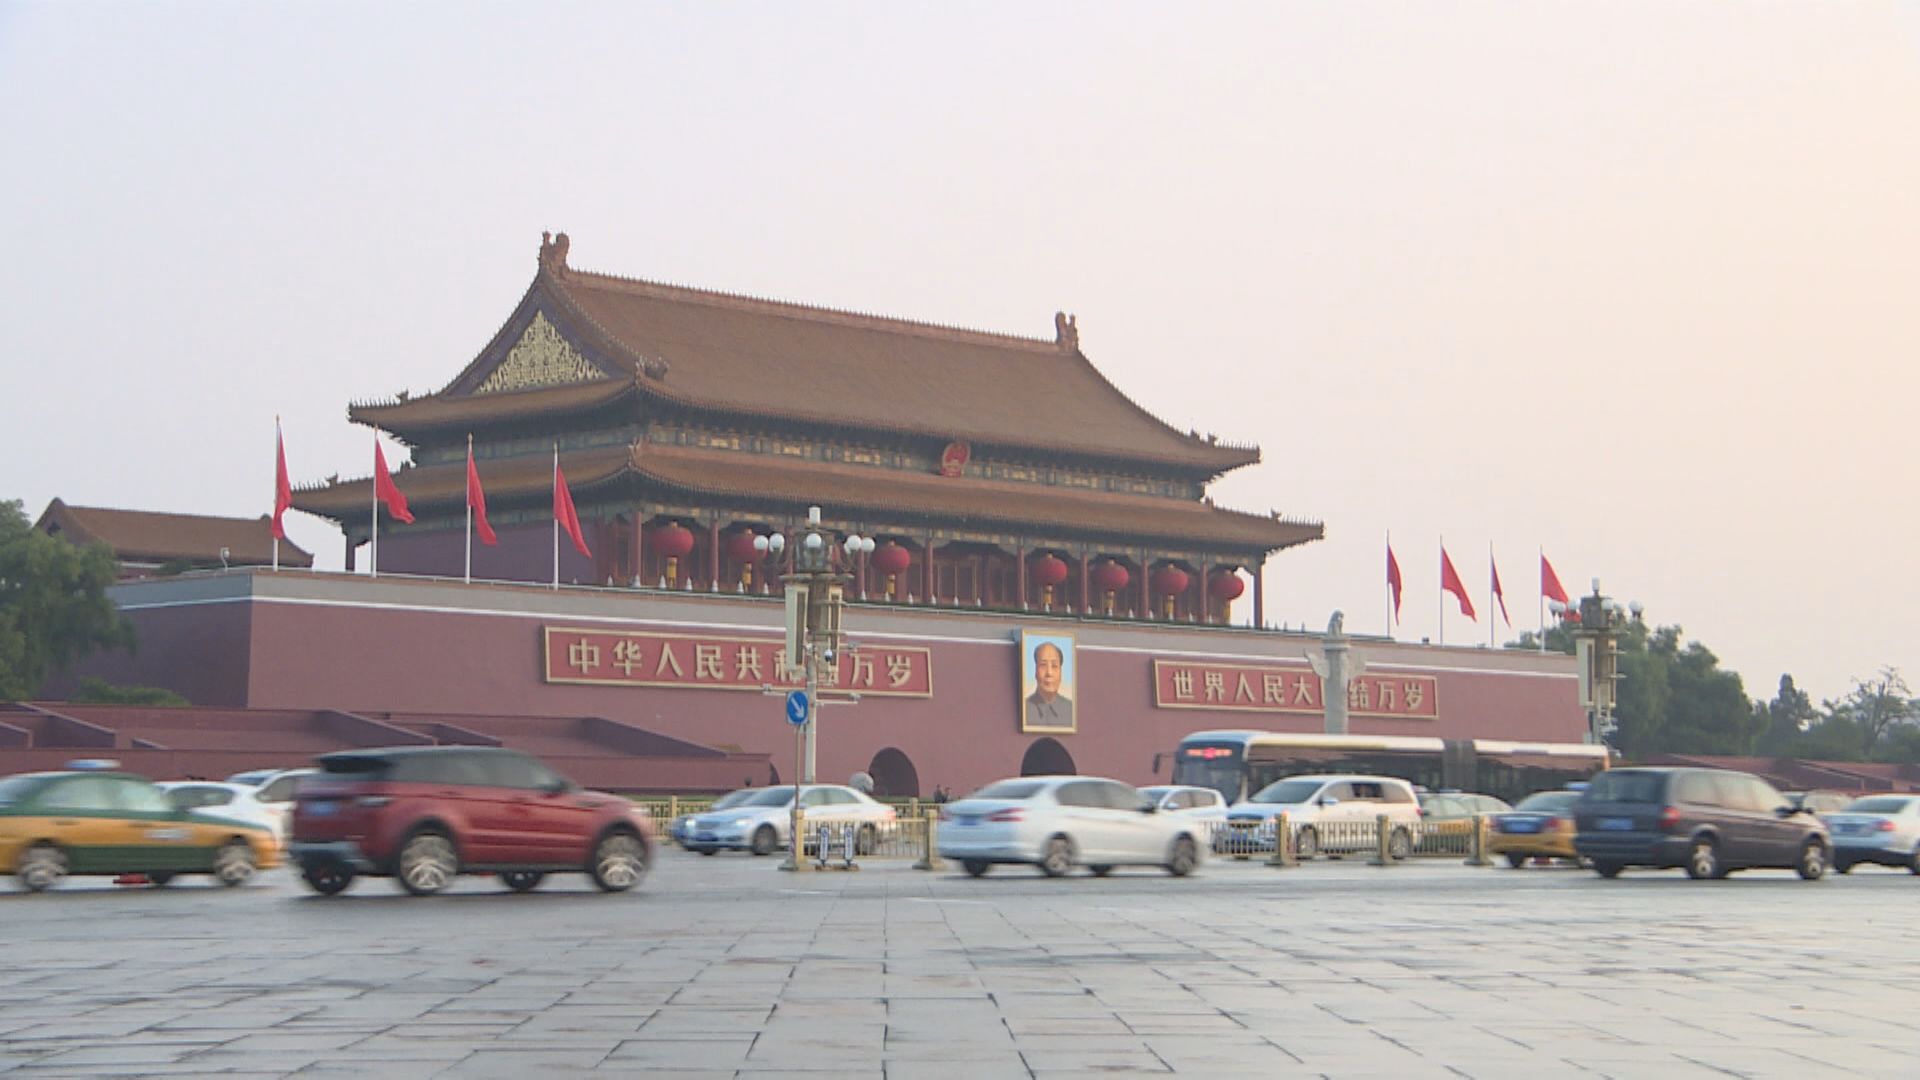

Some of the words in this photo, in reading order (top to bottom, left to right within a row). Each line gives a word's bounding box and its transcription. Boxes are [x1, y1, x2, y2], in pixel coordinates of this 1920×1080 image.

[1173, 670, 1424, 710] 世界人民大结万岁
